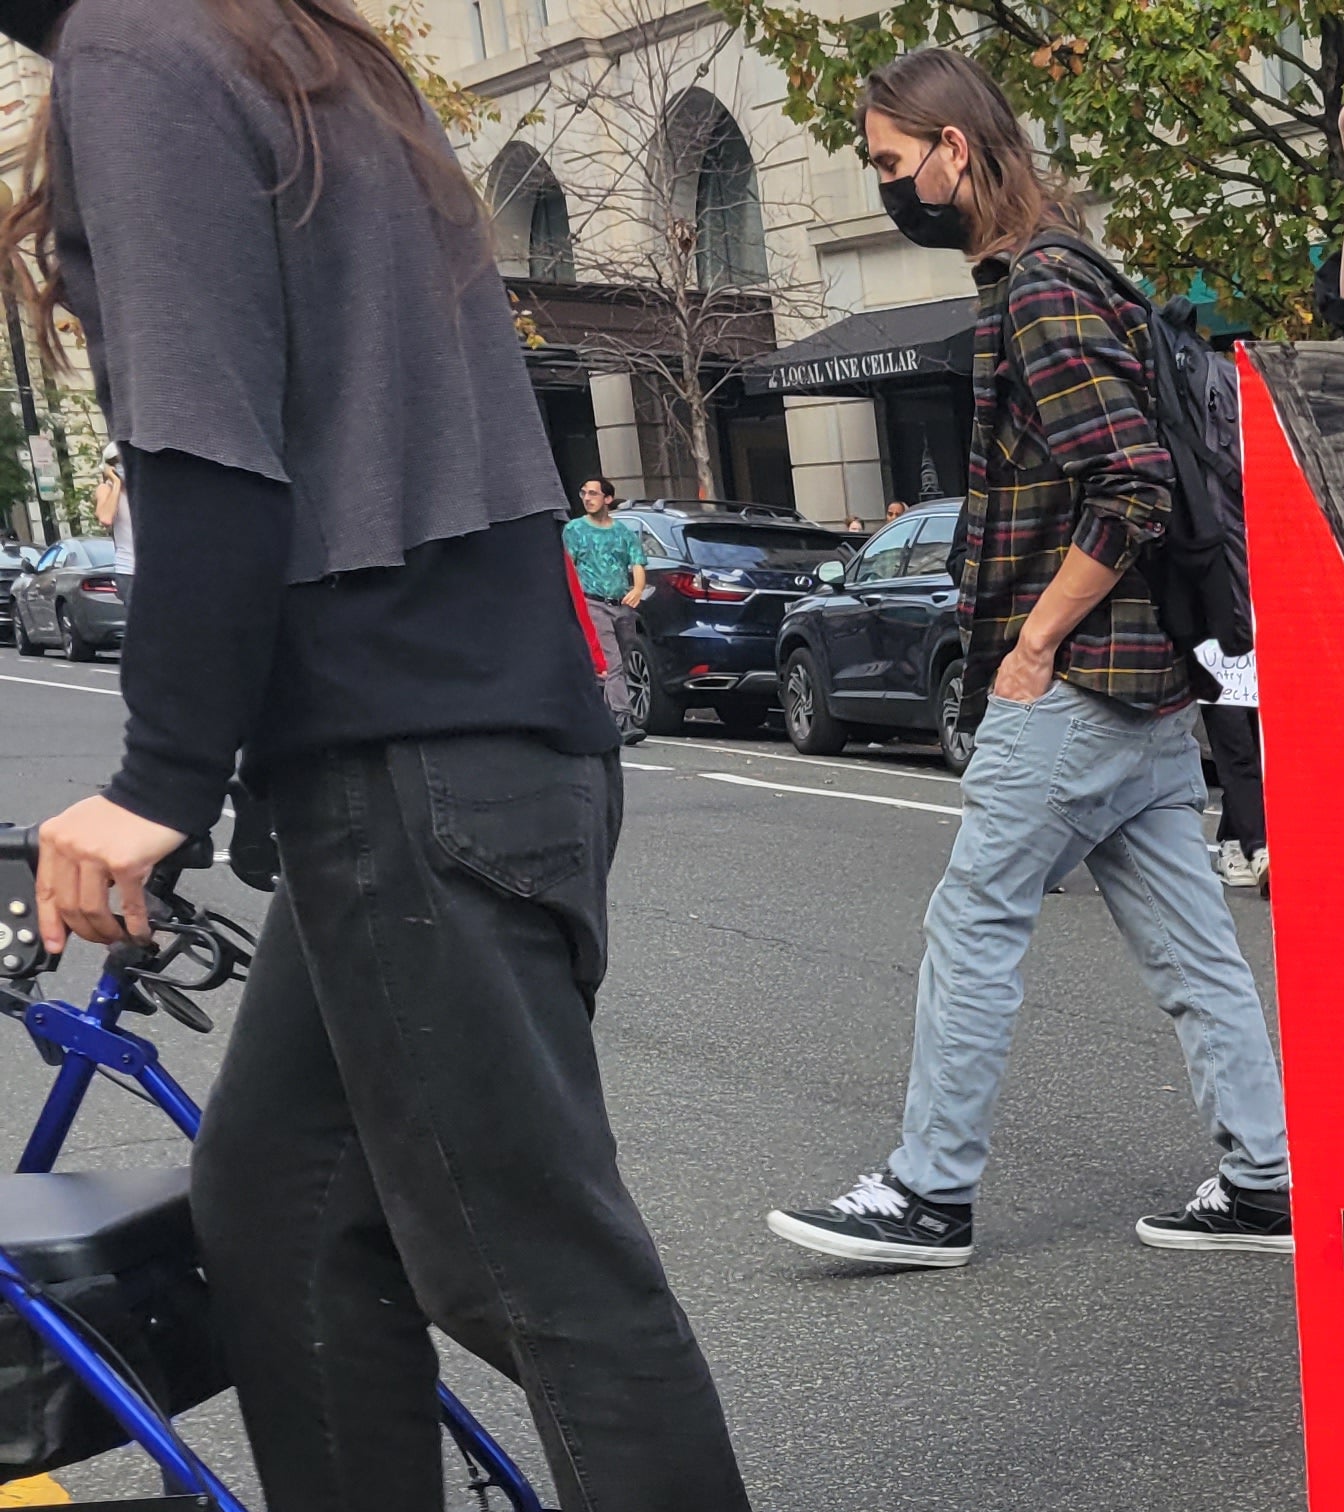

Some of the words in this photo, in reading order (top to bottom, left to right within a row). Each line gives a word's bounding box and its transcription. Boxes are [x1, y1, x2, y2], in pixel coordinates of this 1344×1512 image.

[779, 362, 825, 388] LOCAL
[824, 355, 860, 383] VINE
[861, 348, 919, 376] CELLAR
